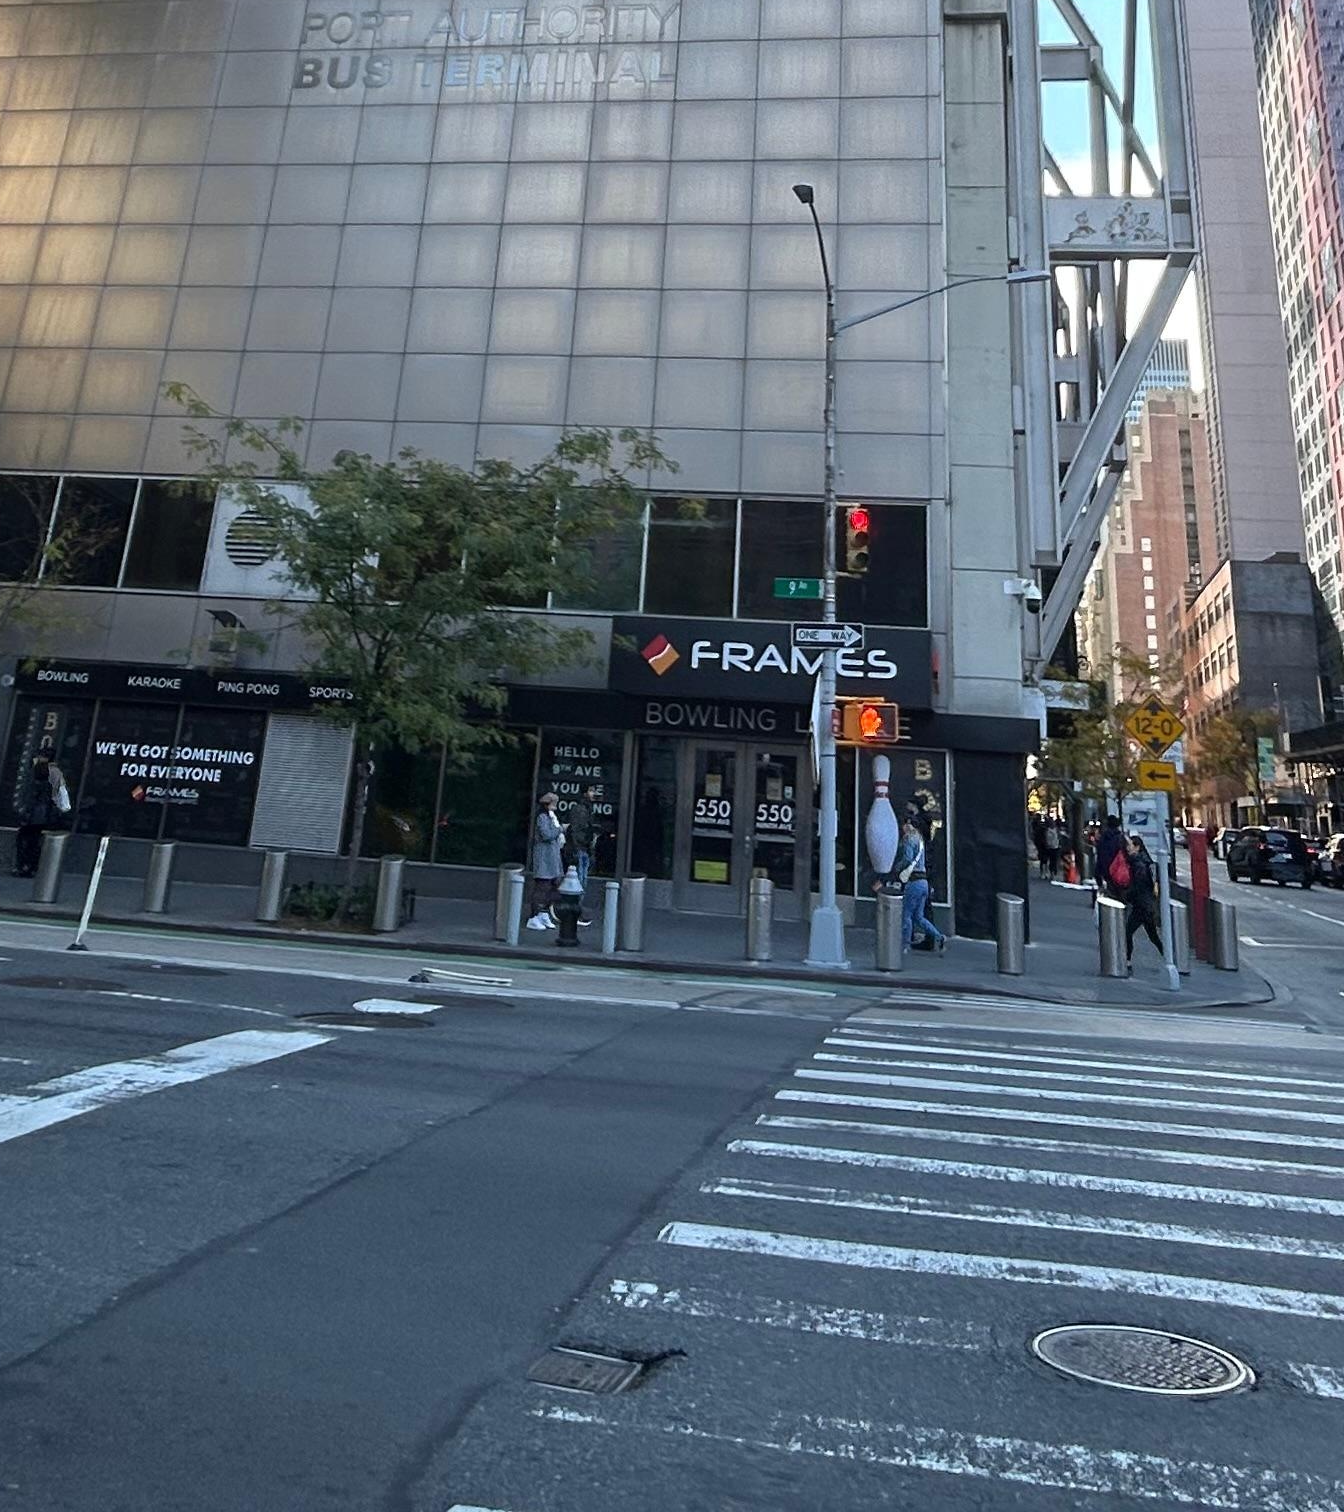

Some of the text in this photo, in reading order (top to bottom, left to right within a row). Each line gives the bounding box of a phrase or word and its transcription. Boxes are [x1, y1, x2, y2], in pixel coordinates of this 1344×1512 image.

[301, 4, 680, 45] PORT AUTHORITY
[292, 50, 676, 89] BUS TERMINAL
[788, 580, 796, 595] 9
[798, 630, 854, 640] ONE WAY
[691, 641, 898, 679] FRAMES
[37, 670, 354, 700] BOWLING KARAOKE PING PONG SPORTS
[646, 702, 777, 733] BOWLING
[96, 741, 255, 765] WE'VE GOT SOMETHING
[554, 746, 600, 759] HELLO
[120, 763, 222, 782] FOR EVERYONE
[575, 766, 602, 777] AVE
[695, 798, 731, 818] 550
[756, 803, 792, 823] 550
